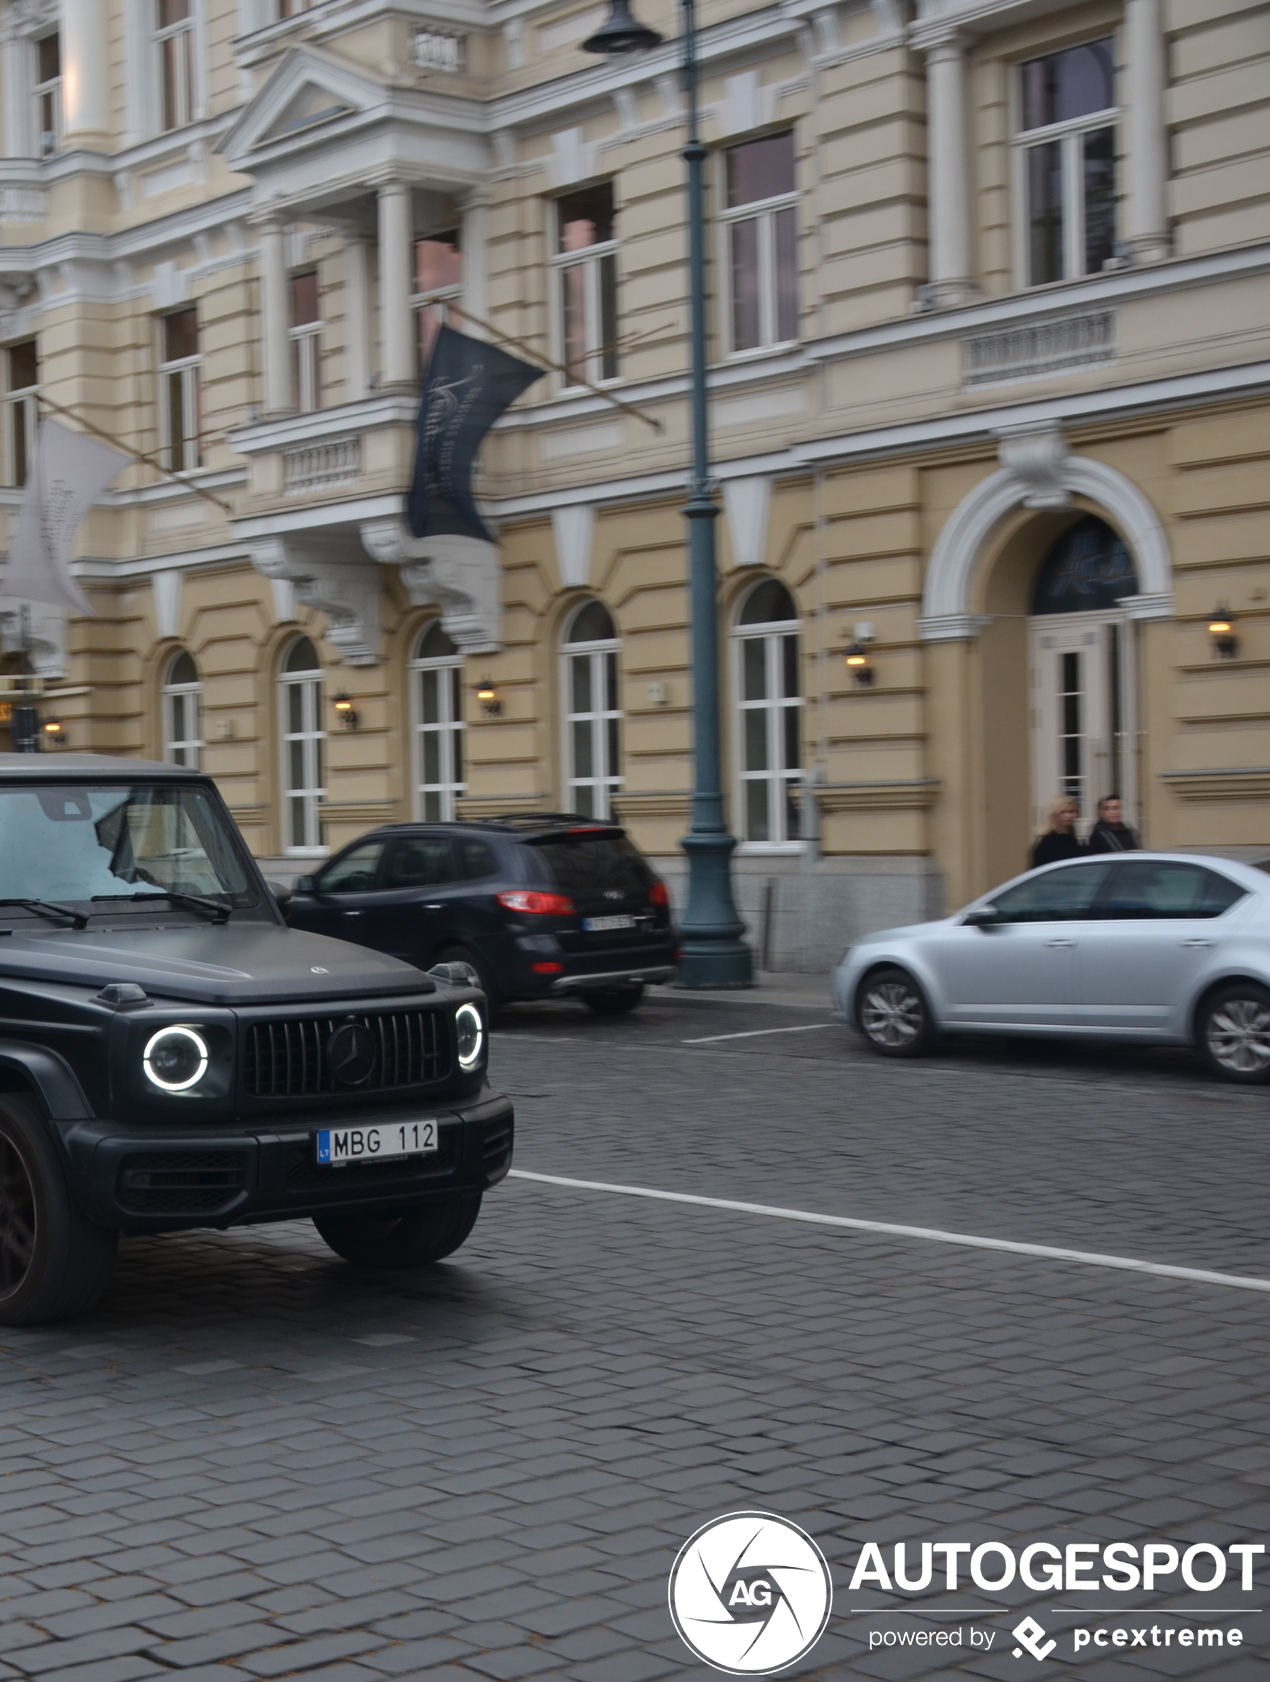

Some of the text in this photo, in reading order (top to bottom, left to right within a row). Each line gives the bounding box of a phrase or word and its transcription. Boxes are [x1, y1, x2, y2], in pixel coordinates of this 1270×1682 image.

[334, 1123, 435, 1157] MBG 112
[319, 1149, 330, 1158] LT
